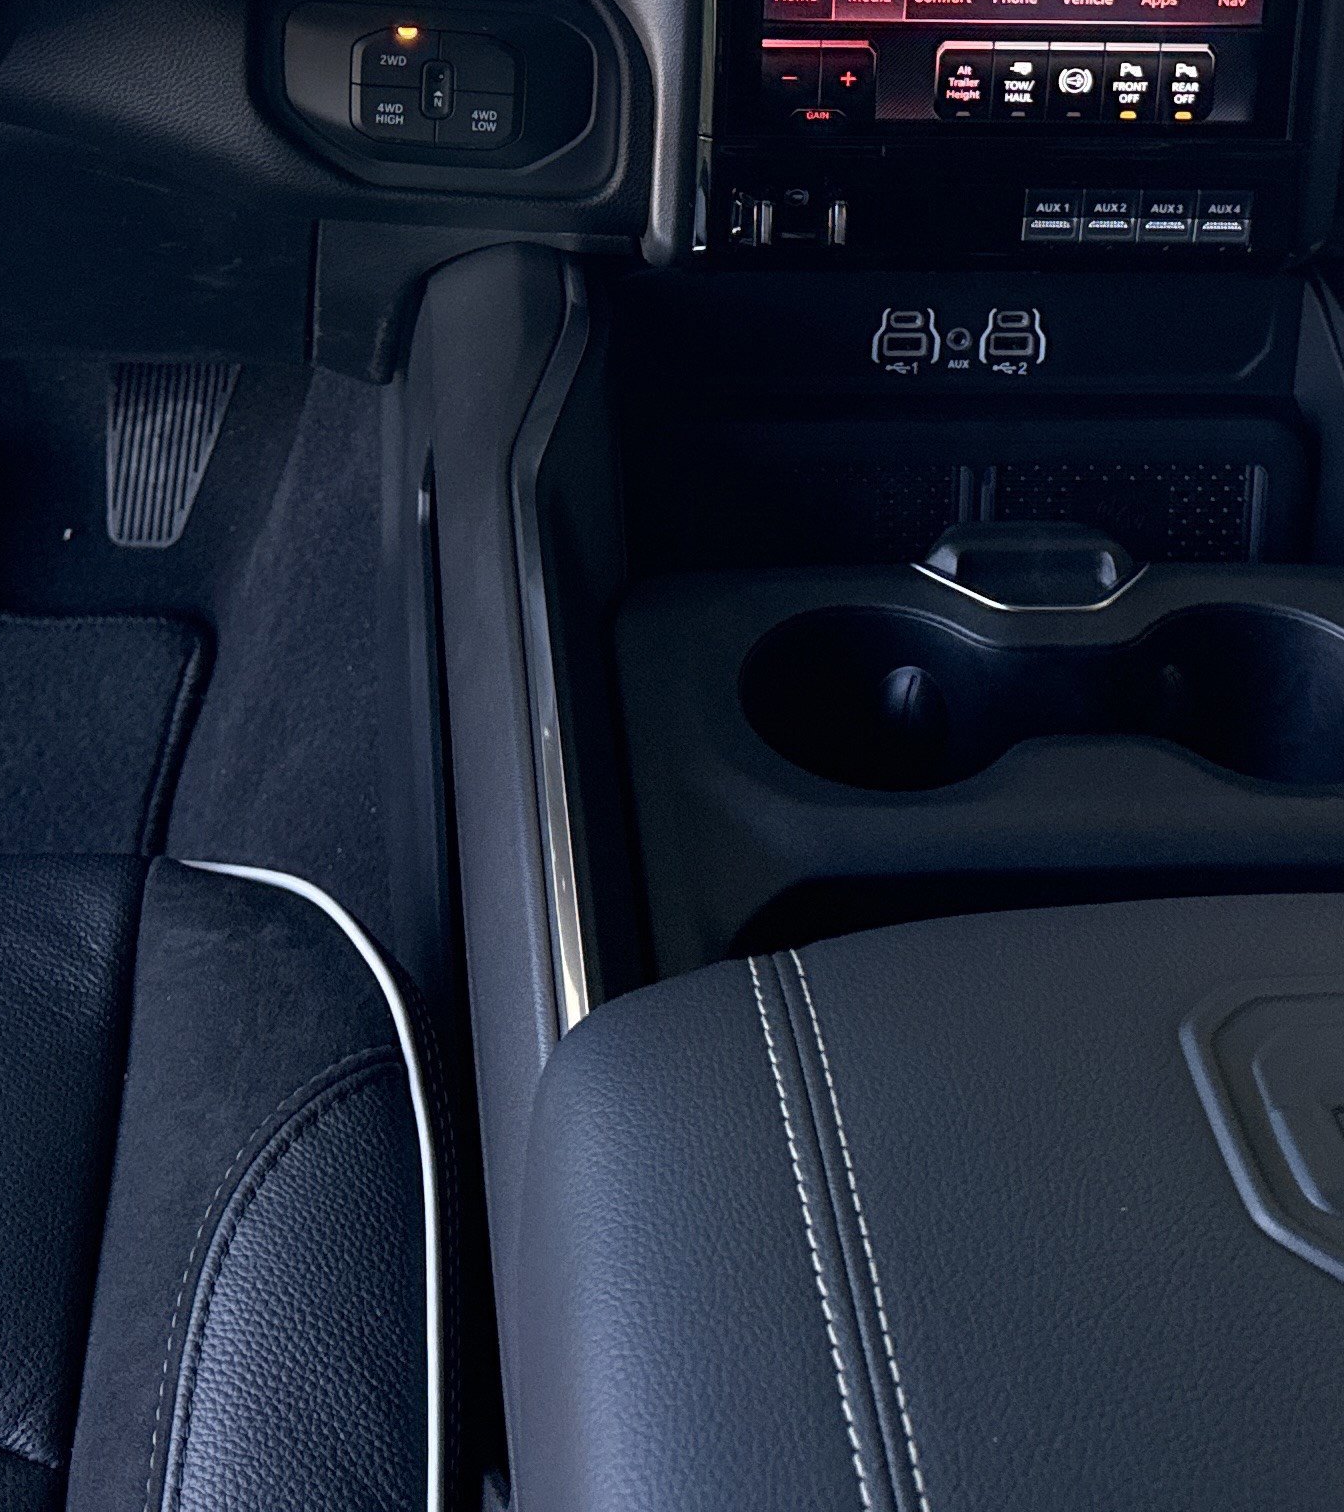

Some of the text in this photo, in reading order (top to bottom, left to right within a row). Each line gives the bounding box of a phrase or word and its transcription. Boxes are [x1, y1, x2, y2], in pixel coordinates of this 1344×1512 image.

[379, 54, 407, 67] 2WD
[947, 77, 981, 88] Trailer
[1004, 80, 1035, 91] TOW/
[1112, 80, 1149, 93] FRONT
[1171, 81, 1200, 94] REAR
[946, 89, 981, 101] Height
[1004, 92, 1034, 103] HAUL
[1117, 93, 1141, 105] OFF
[1173, 94, 1196, 106] OFF
[376, 102, 404, 114] 4WD
[433, 97, 443, 108] N
[375, 114, 404, 126] HIGH
[471, 109, 498, 121] 4WD
[805, 110, 830, 121] GAIN
[471, 121, 497, 133] LOW
[1035, 202, 1070, 214] AUX 1
[1093, 202, 1127, 214] AUX 2
[1150, 203, 1183, 215] AUX 3
[1208, 203, 1241, 215] AUX 4
[912, 362, 919, 375] 1
[947, 359, 970, 369] AUX
[1017, 361, 1028, 375] 2
